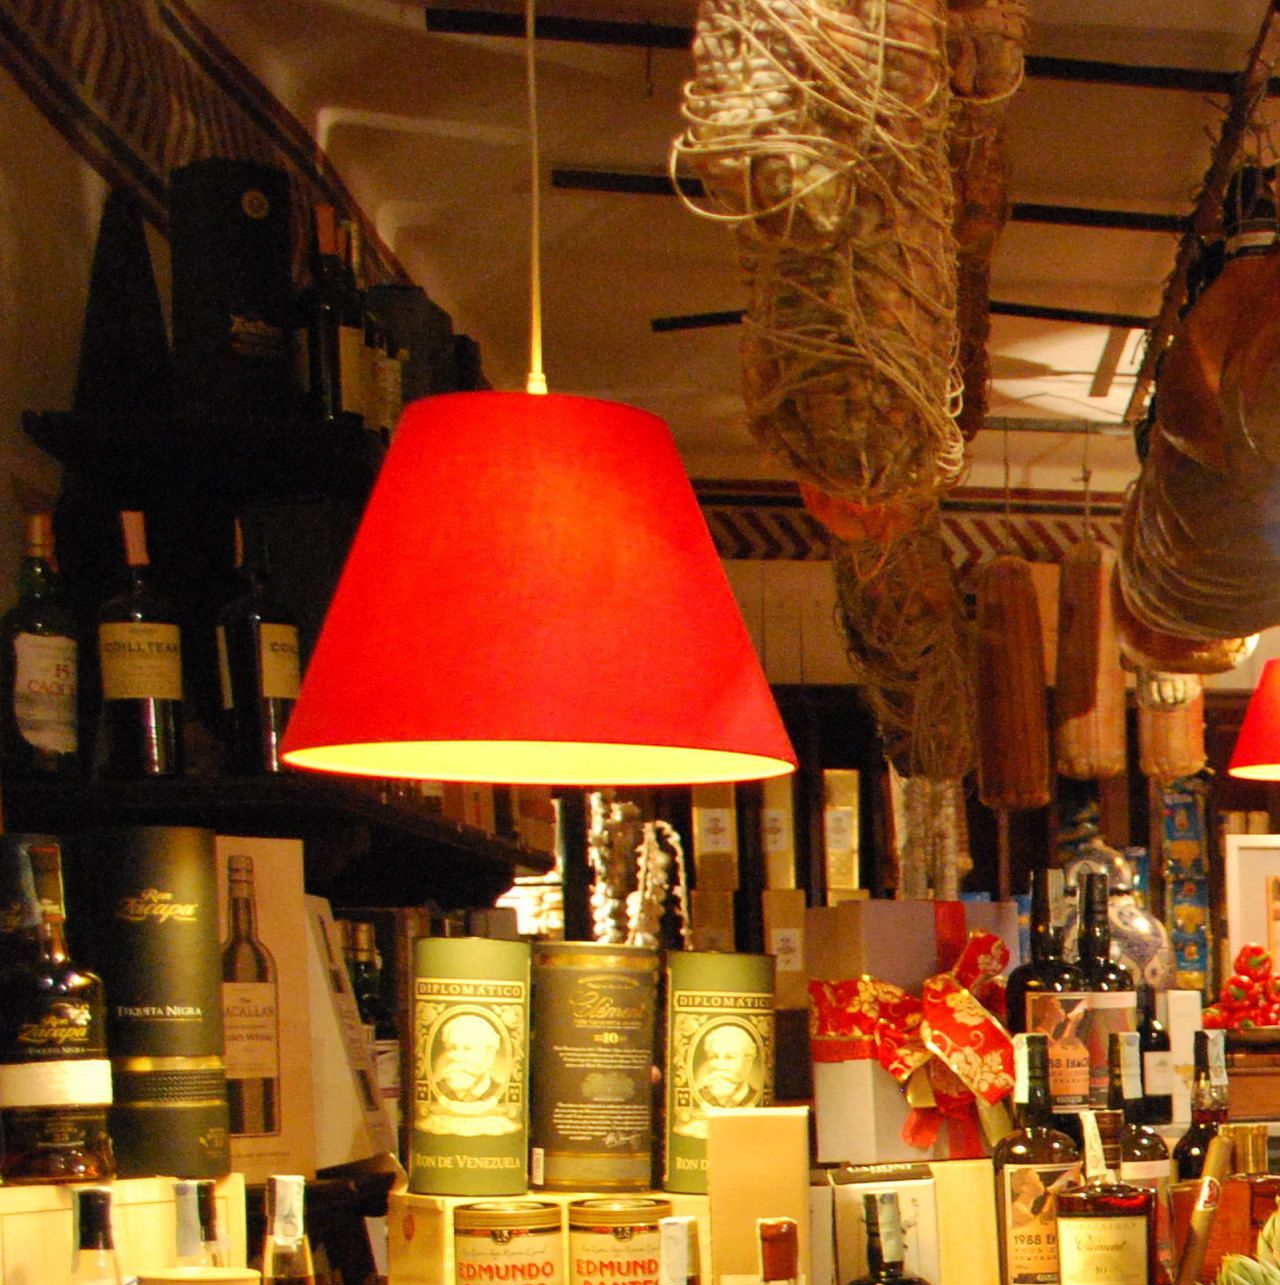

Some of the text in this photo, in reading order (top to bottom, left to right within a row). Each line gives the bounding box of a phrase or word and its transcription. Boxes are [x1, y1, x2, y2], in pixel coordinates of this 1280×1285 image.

[166, 1005, 202, 1017] NEGRA
[438, 1155, 453, 1168] DE
[456, 1155, 521, 1170] VENEZUELA
[676, 1157, 709, 1171] RON D
[1013, 1234, 1042, 1246] 1988
[459, 1261, 554, 1281] EDMUNDO
[576, 1258, 660, 1277] EDMUND
